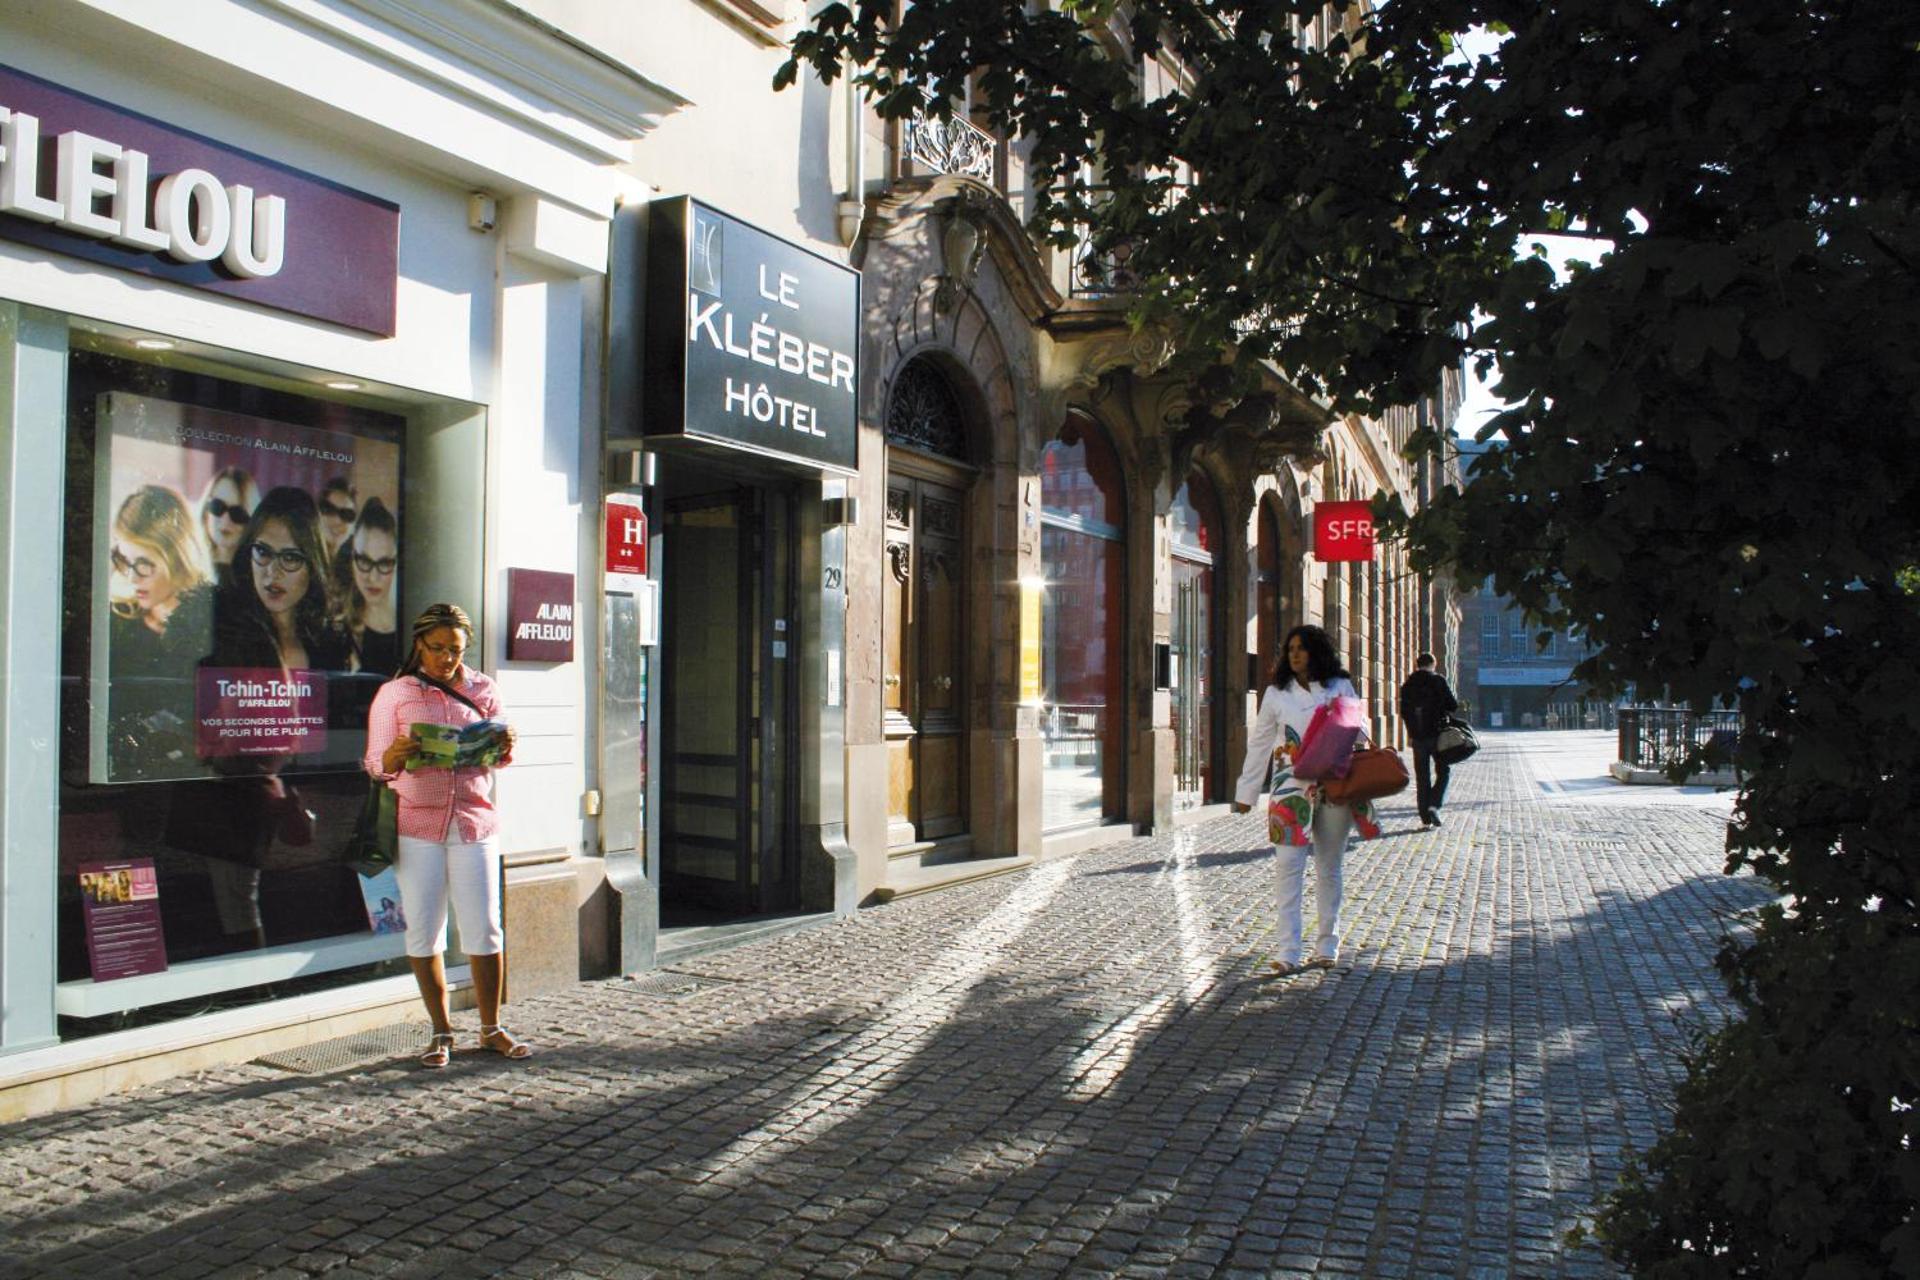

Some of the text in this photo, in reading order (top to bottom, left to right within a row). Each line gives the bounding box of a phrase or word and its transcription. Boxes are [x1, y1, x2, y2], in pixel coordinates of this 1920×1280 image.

[0, 105, 286, 278] LELOU
[759, 263, 800, 310] LE
[690, 293, 855, 393] KLÉBER
[725, 377, 827, 438] HÔTEL
[254, 438, 291, 453] ALAIN
[293, 445, 353, 463] AFFLELOU
[623, 518, 643, 545] H
[1328, 519, 1371, 540] SFR
[824, 566, 841, 589] 29
[536, 603, 571, 620] ALAIN
[516, 622, 572, 641] AFFLELOU
[216, 679, 311, 697] Tchin-Tchin
[238, 698, 291, 708] D'AFFLELOU
[201, 716, 324, 726] VOS SECONDES LUNETTES
[219, 728, 251, 737] POUR
[264, 727, 280, 736] DE
[281, 726, 309, 736] PLUS
